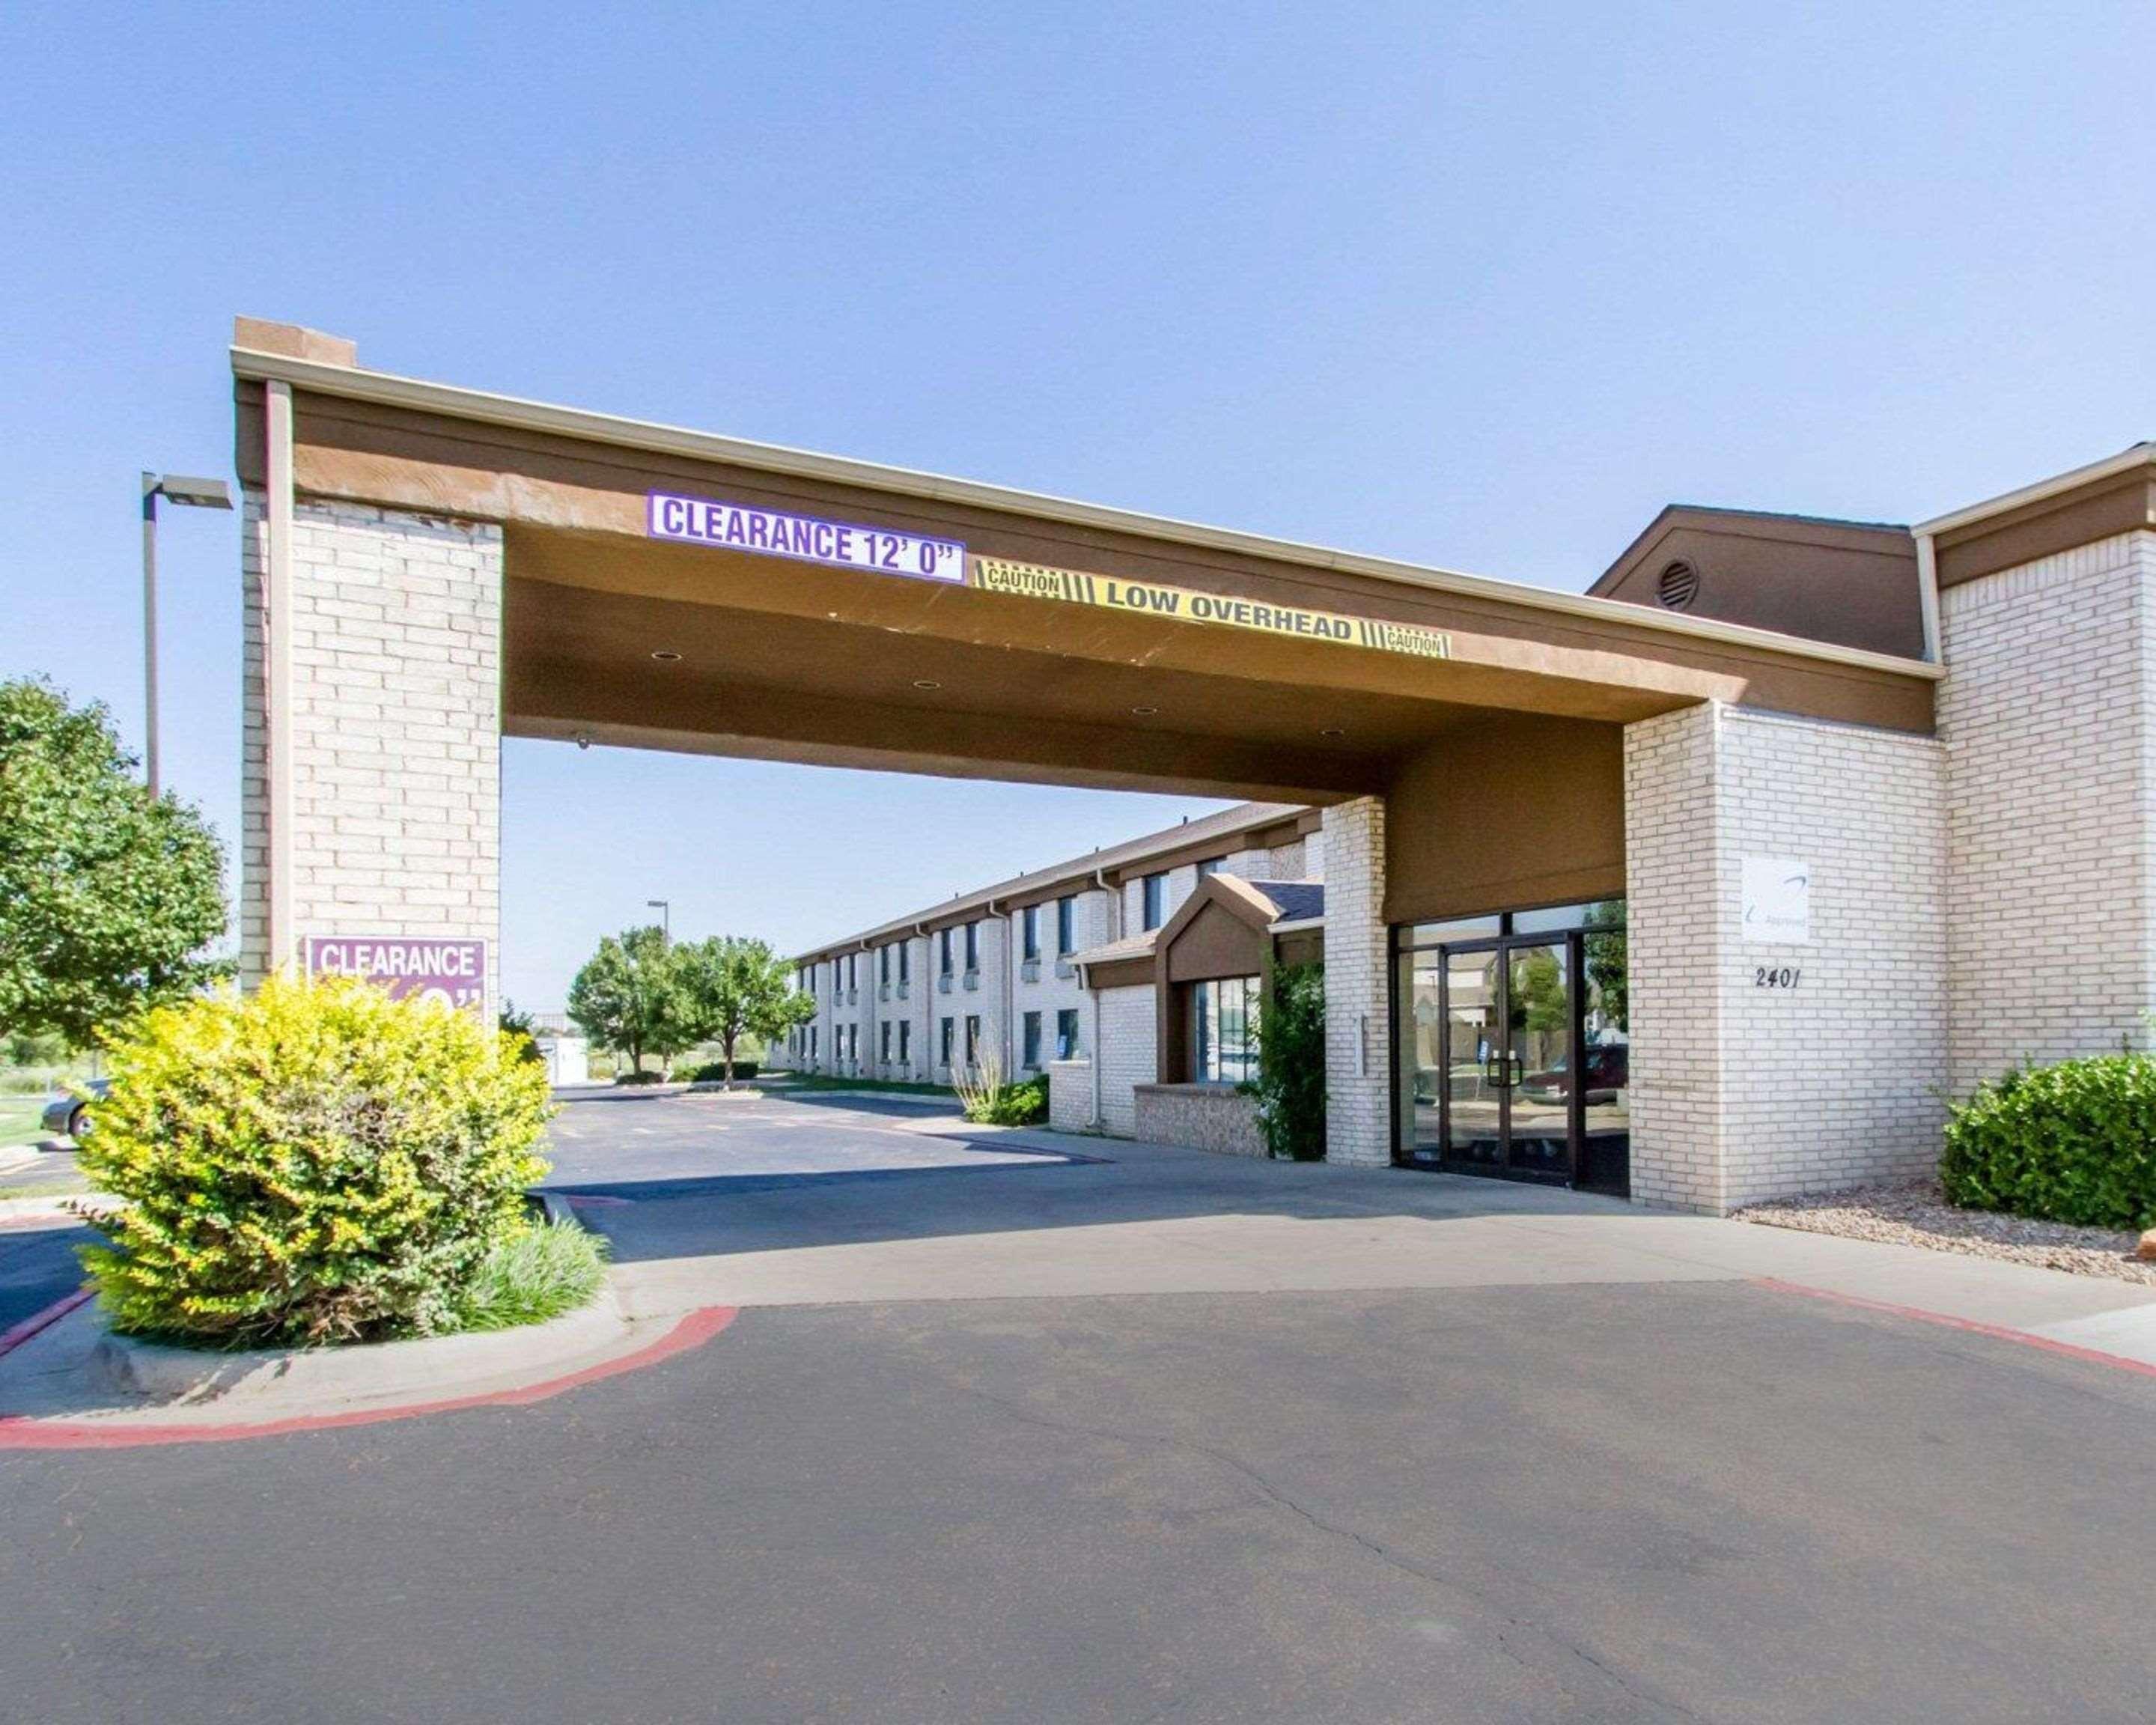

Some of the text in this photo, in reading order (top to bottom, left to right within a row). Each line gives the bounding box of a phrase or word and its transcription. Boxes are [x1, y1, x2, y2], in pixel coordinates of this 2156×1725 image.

[663, 499, 852, 561] CLEARANCE
[987, 567, 1441, 654] CAUTION LOW OVERHEAD CAUTION
[320, 943, 476, 976] CLEARANCE
[1756, 967, 1801, 988] 2401
